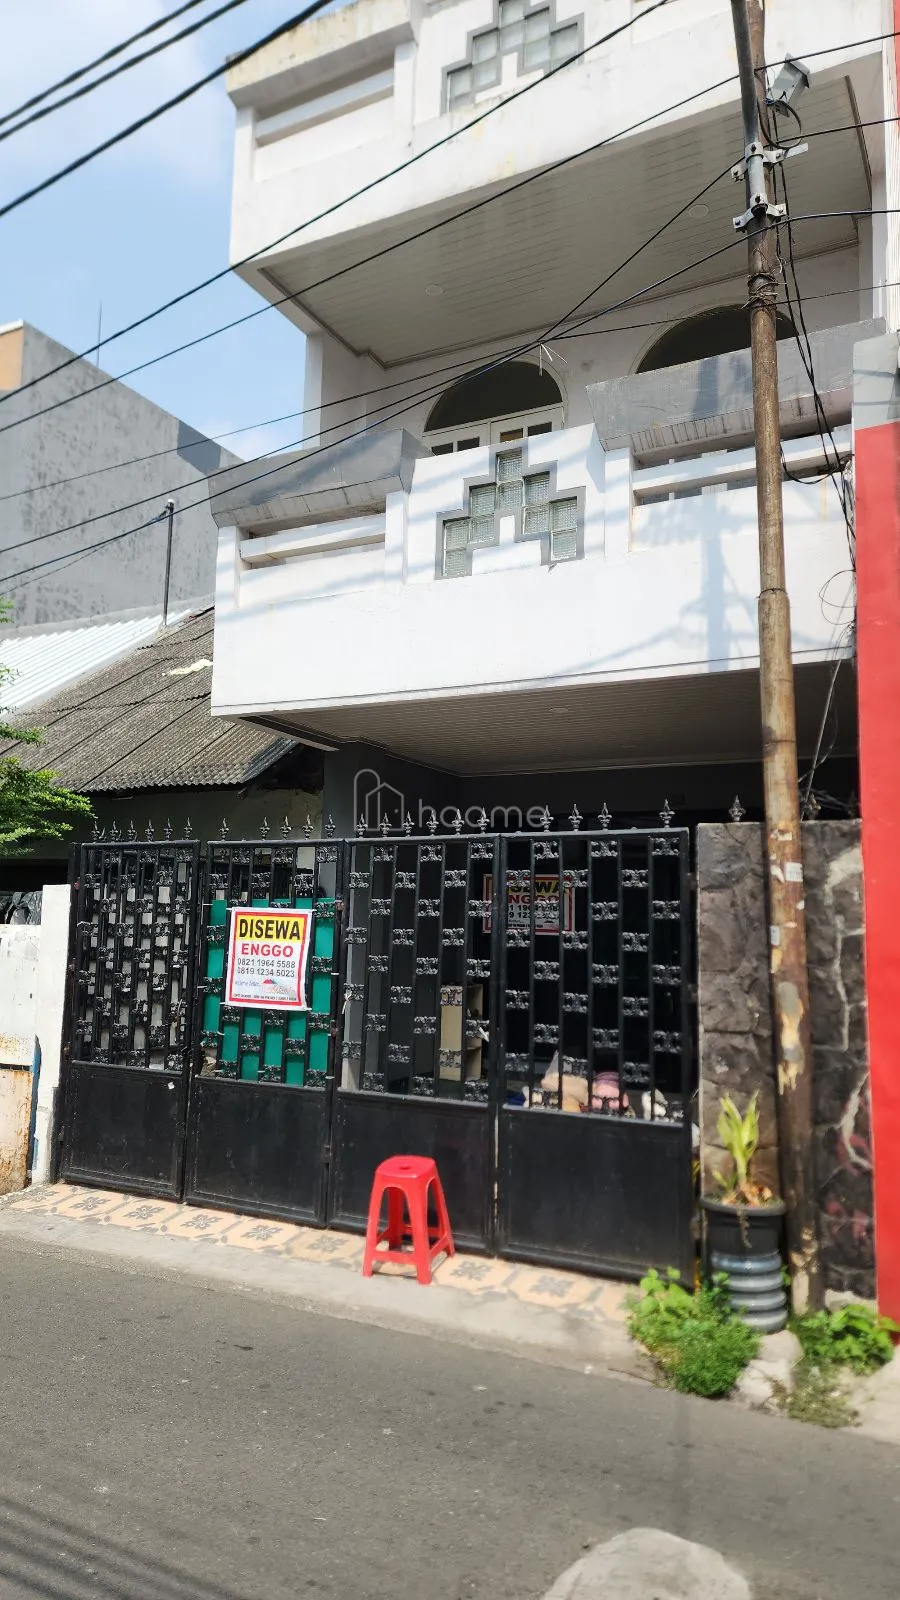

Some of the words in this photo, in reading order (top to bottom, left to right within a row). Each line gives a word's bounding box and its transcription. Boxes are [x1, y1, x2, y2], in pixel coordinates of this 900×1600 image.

[239, 918, 300, 940] DISEWA
[241, 943, 294, 957] ENGGO
[237, 957, 255, 966] 0821
[257, 958, 275, 967] 1964
[276, 960, 296, 969] 5588
[257, 968, 274, 976] 1234
[276, 969, 295, 978] 5023
